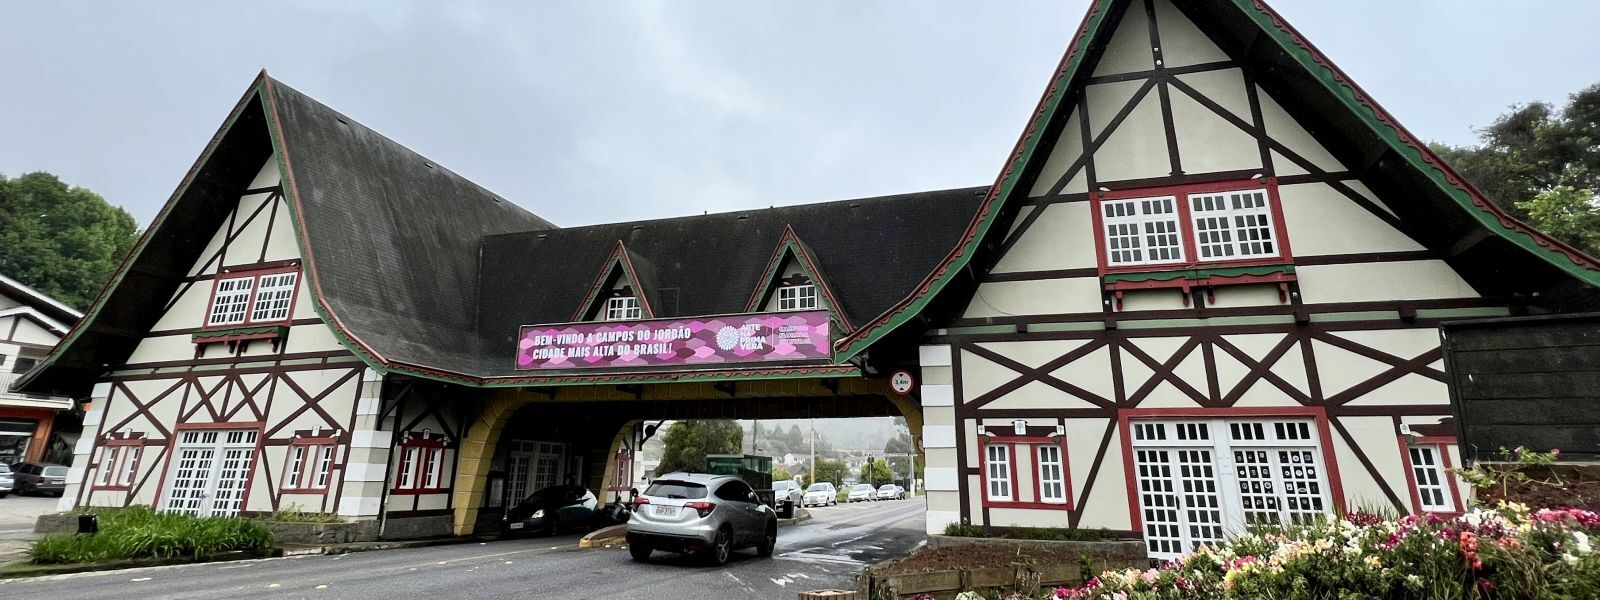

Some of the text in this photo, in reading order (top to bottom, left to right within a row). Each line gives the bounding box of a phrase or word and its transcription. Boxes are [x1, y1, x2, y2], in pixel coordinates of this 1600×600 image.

[534, 325, 691, 346] BEM-VINDO A CAMPOS DO JORDÃO
[741, 323, 761, 331] ARTE
[532, 342, 673, 360] CIDADE MAIS ALTA DO BRASIL!
